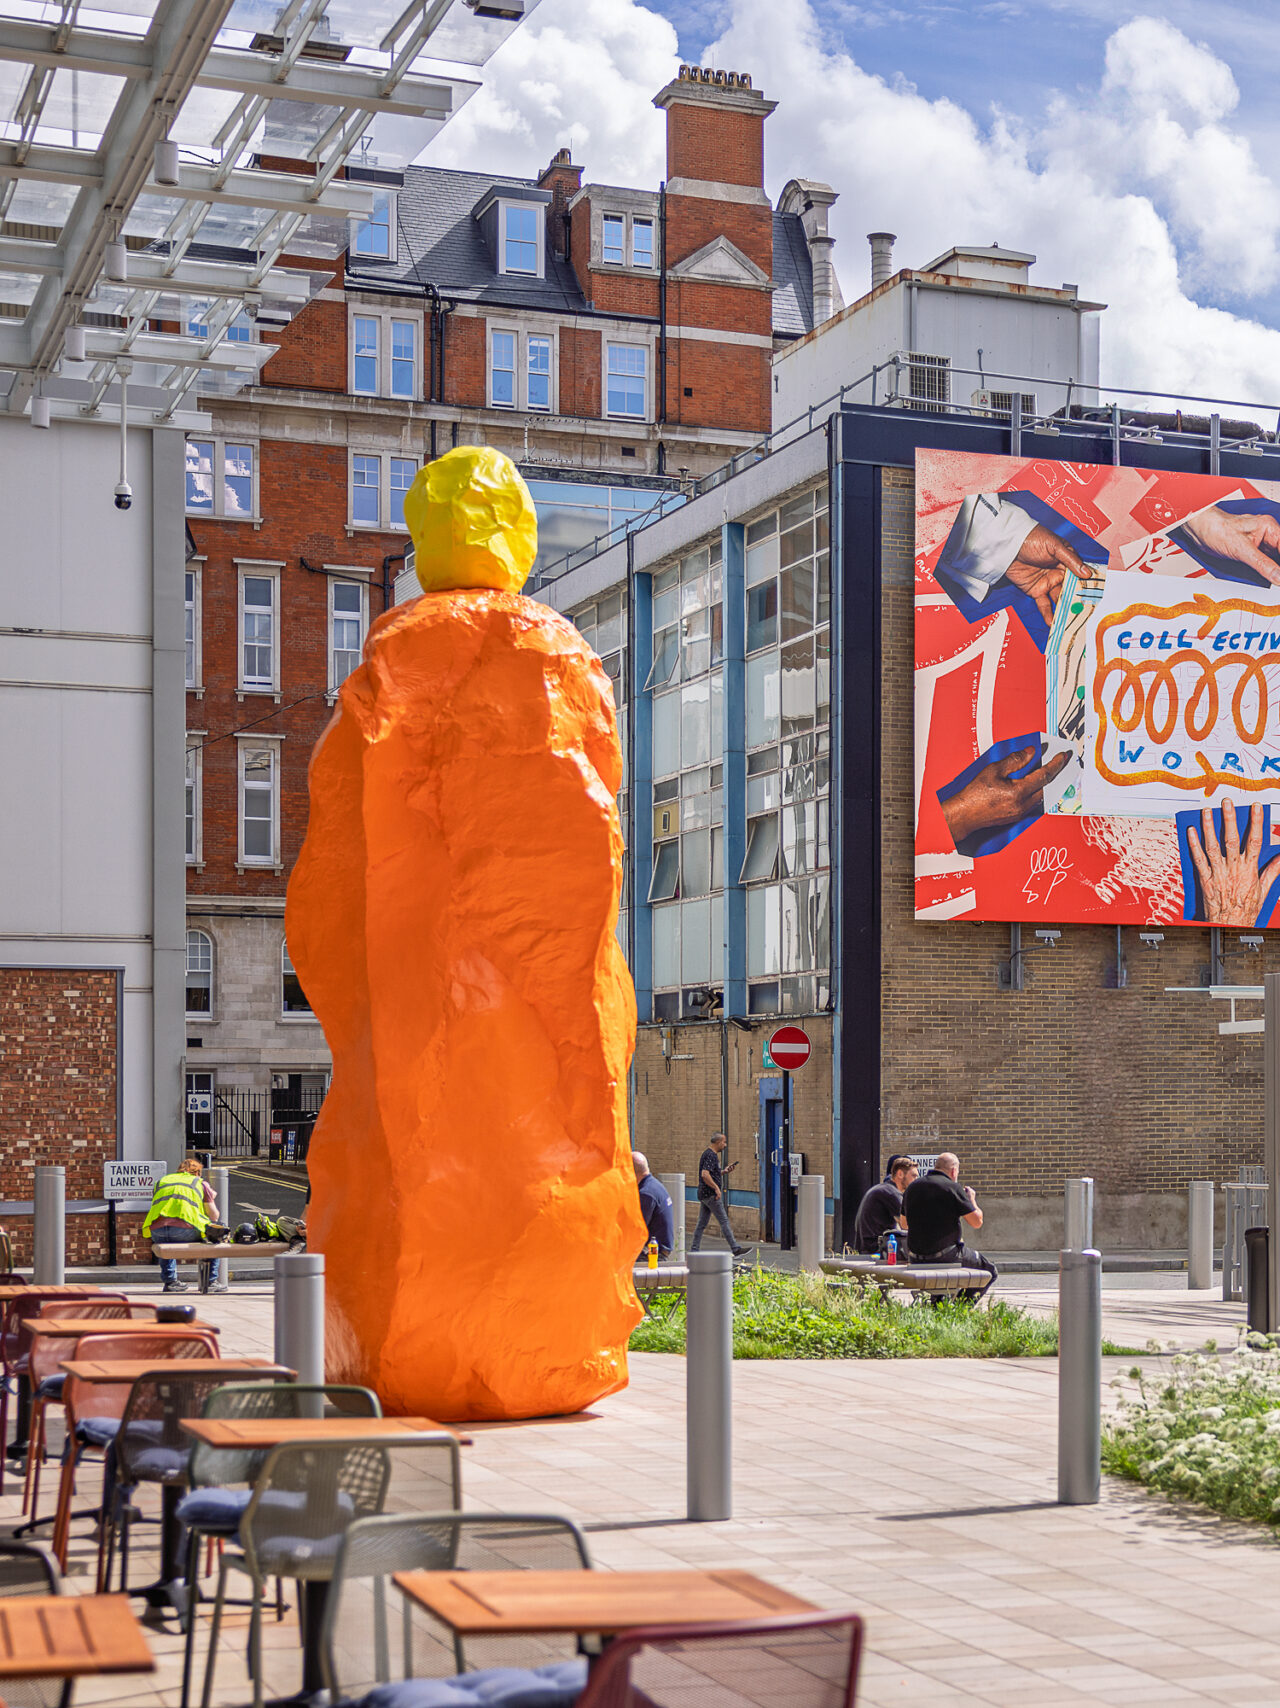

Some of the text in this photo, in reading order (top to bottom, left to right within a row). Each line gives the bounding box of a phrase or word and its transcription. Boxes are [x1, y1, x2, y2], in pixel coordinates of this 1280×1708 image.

[110, 1165, 150, 1175] TANNER
[110, 1176, 154, 1187] LANE W2
